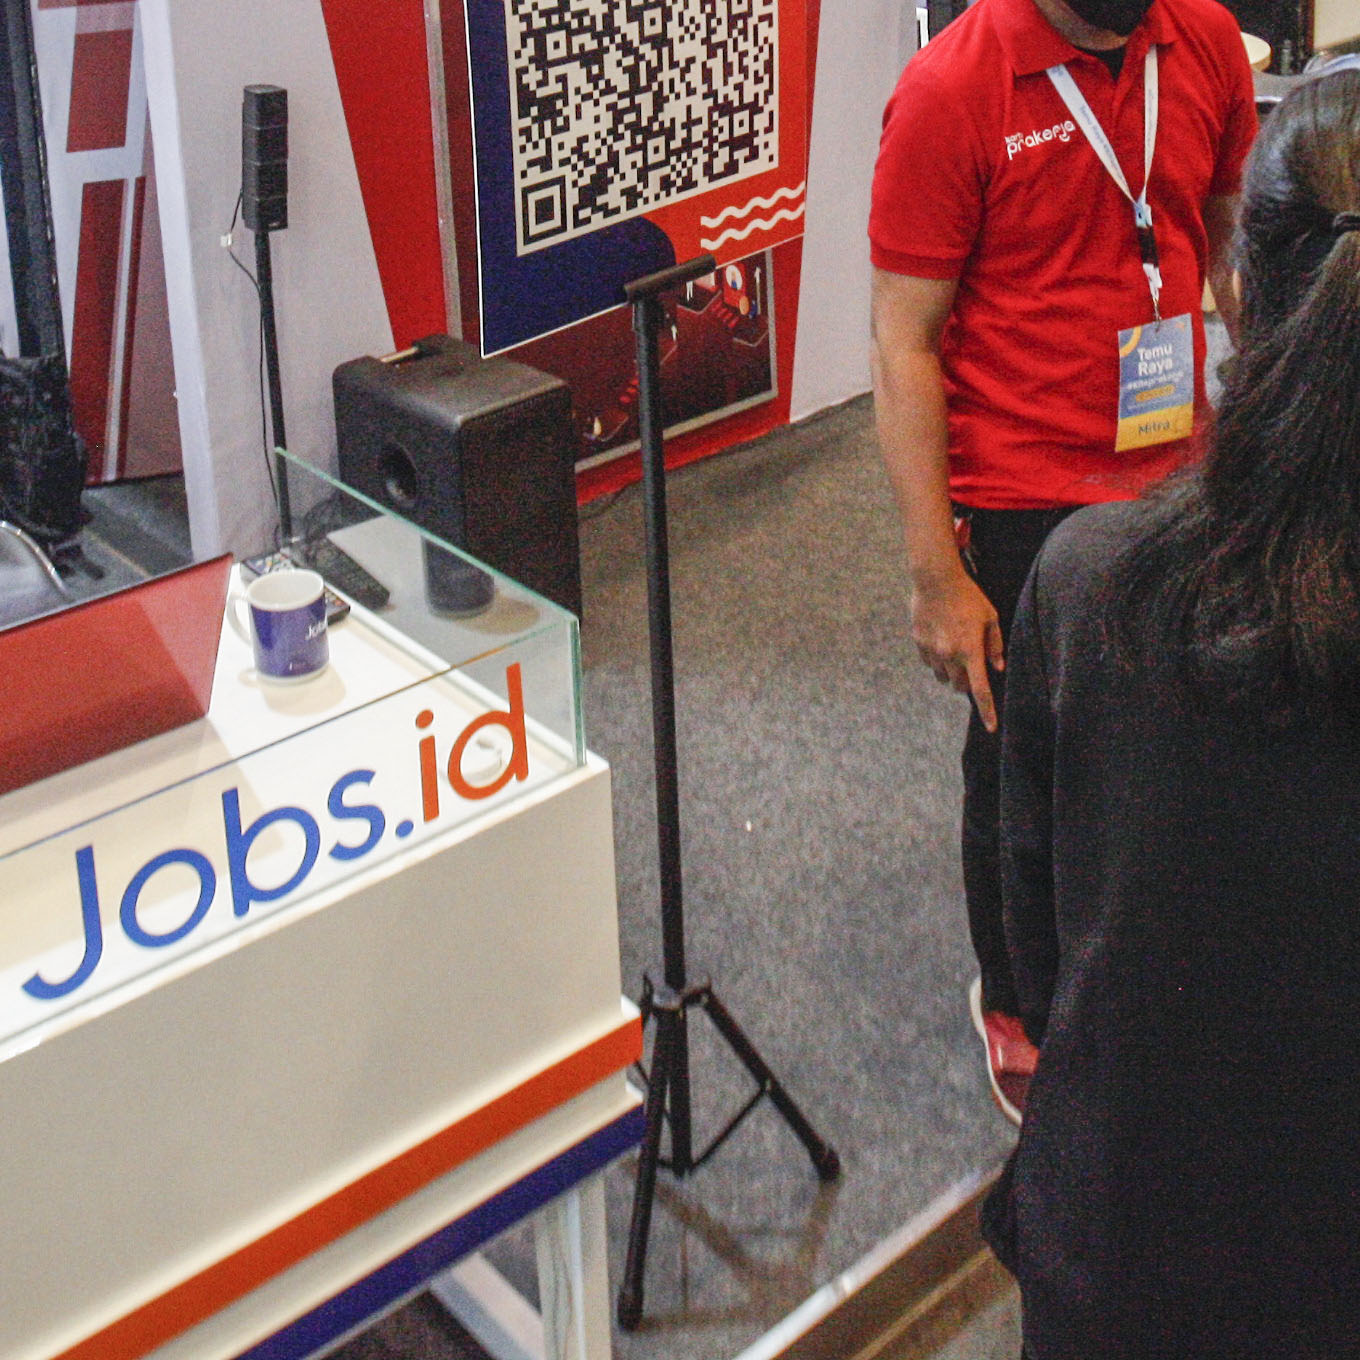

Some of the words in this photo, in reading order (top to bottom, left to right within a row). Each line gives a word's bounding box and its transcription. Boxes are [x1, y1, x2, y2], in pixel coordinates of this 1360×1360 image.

[1137, 343, 1173, 362] Temu
[1138, 357, 1173, 378] Raya
[21, 662, 530, 1001] Jobs.id
